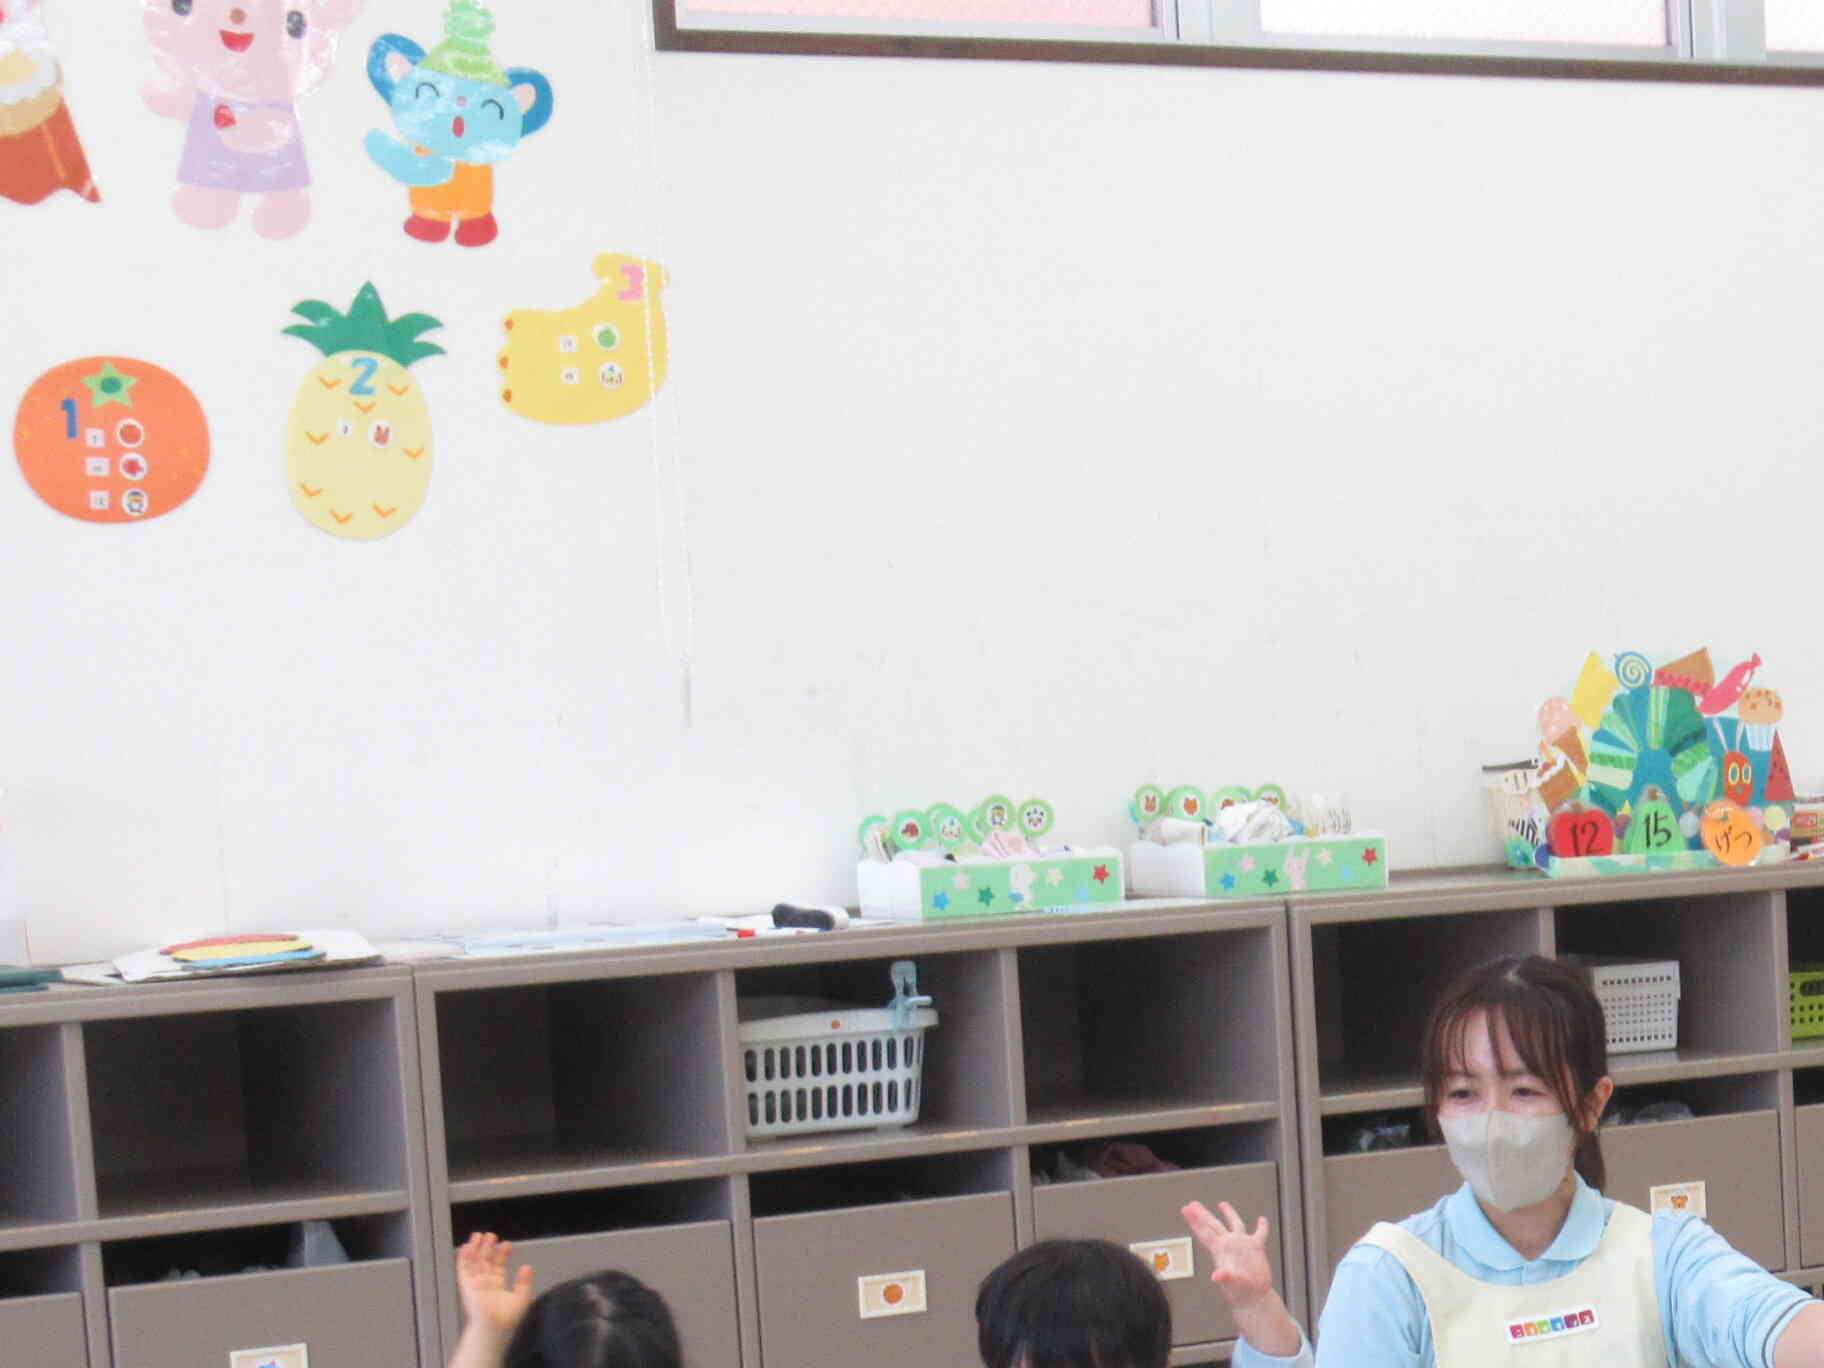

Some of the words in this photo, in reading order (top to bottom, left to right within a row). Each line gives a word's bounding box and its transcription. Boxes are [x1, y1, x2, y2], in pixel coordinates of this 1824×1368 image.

[617, 263, 644, 301] 3
[350, 357, 379, 395] 2
[62, 398, 78, 439] 1
[1569, 820, 1604, 857] 12
[1644, 810, 1672, 848] 15
